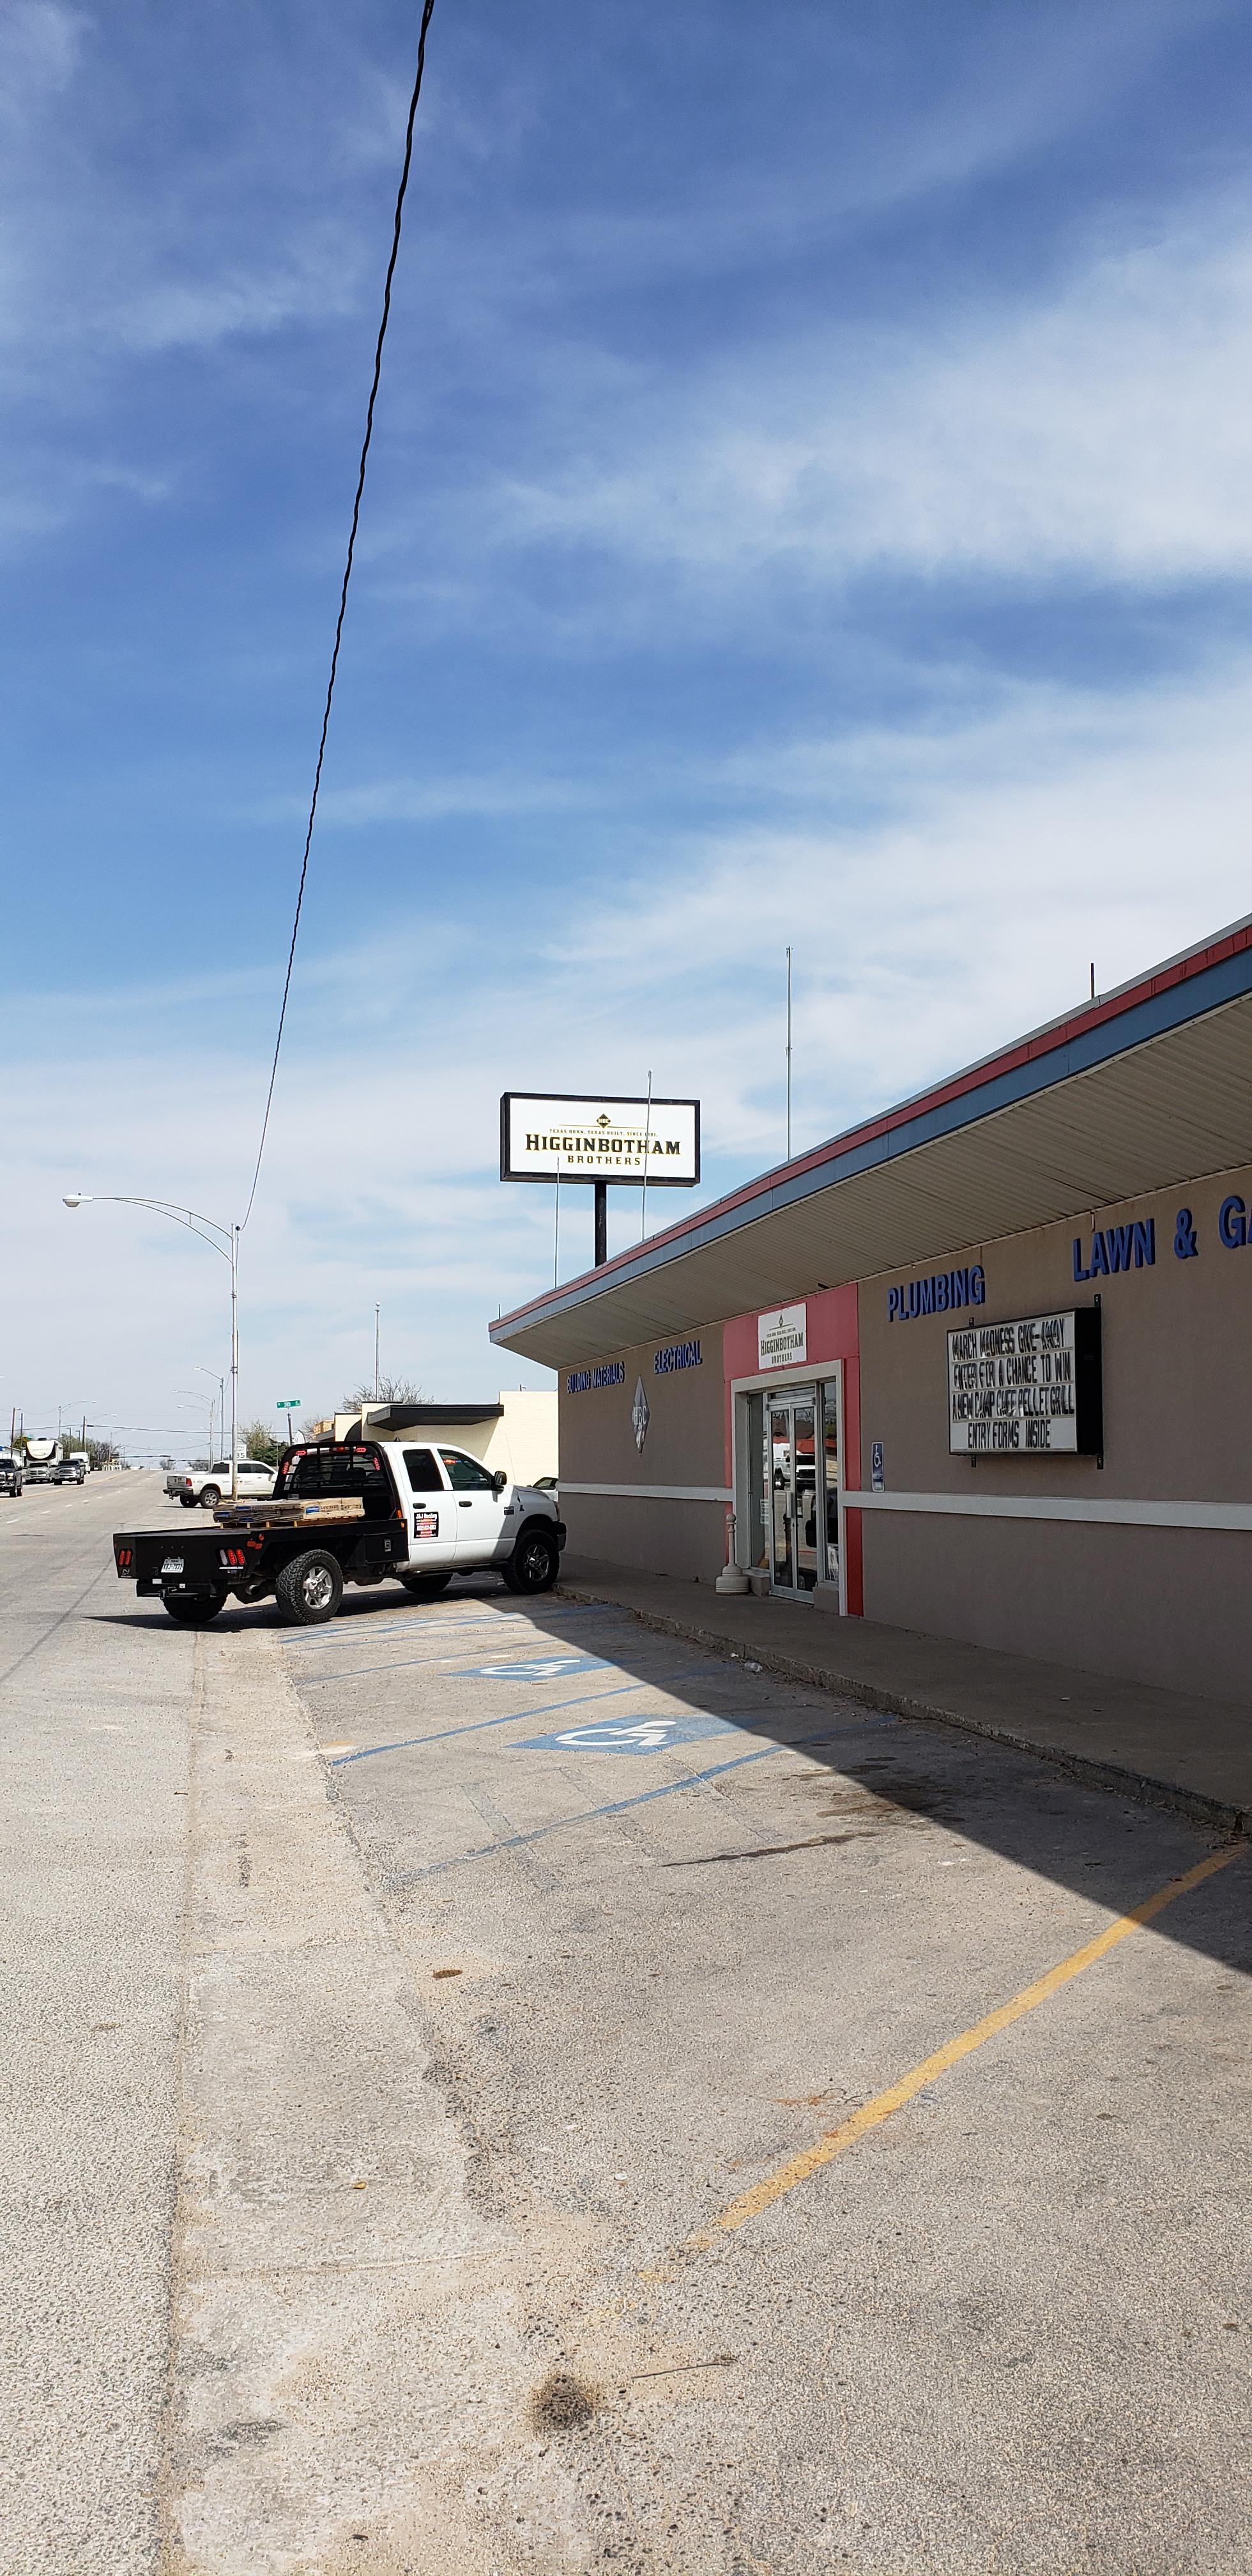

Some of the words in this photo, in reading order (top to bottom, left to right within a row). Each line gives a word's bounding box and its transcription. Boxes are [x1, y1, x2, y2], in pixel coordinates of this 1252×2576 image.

[525, 1133, 681, 1155] HIGGINBOTHAM
[567, 1155, 641, 1165] BROTHERS
[1073, 1218, 1156, 1282] LAWN
[1173, 1208, 1198, 1259] &
[1218, 1195, 1252, 1248] G
[887, 1264, 986, 1322] PLUMBING
[654, 1340, 703, 1374] ELECTRICAL
[761, 1332, 804, 1356] HIGGINBOTHAM
[772, 1352, 792, 1364] BROTHERS
[952, 1332, 977, 1361] MARCH
[980, 1326, 1015, 1357] MADNESS
[567, 1370, 592, 1394] BUILDING
[593, 1361, 625, 1388] MATERIALS
[954, 1363, 977, 1390] ENTER
[979, 1361, 995, 1388] FOR
[998, 1360, 1004, 1386] A
[1006, 1355, 1037, 1386] CHANCE
[1041, 1353, 1051, 1383] TO
[1055, 1351, 1071, 1381] WIN
[633, 1406, 646, 1425] HBC
[952, 1394, 957, 1420] A
[958, 1392, 973, 1419] NEW
[975, 1390, 995, 1418] CAMP
[1018, 1386, 1050, 1416] PELLET
[1050, 1384, 1074, 1415] GRILL
[968, 1422, 991, 1448] ENTRY
[992, 1420, 1019, 1448] FORMS
[1025, 1419, 1051, 1448] INSIDE
